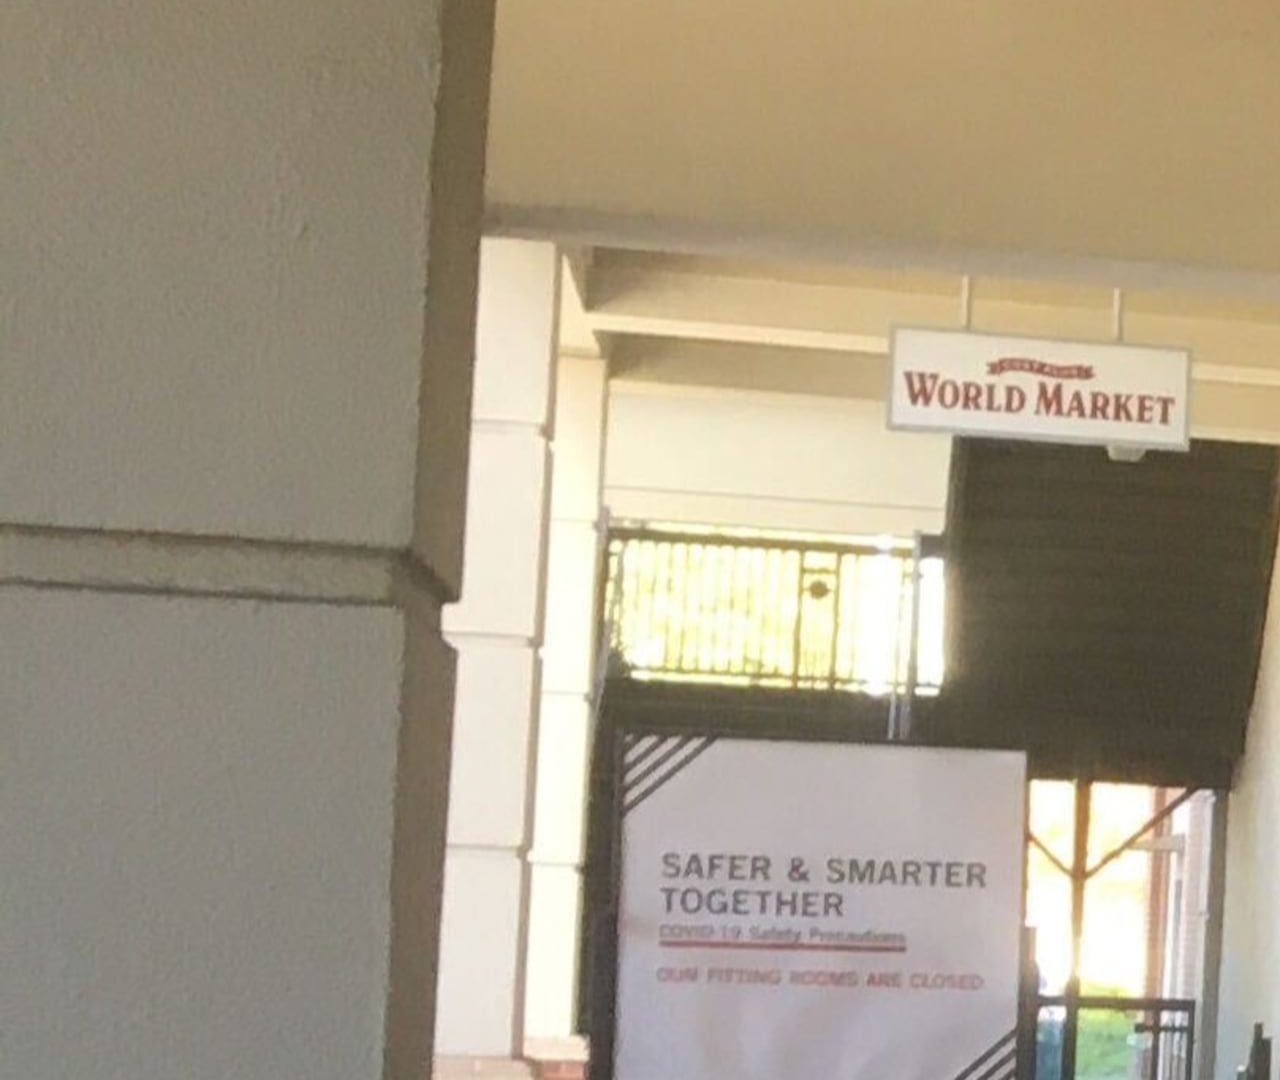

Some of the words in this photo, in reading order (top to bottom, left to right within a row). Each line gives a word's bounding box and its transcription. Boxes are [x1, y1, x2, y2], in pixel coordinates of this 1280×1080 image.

[903, 370, 1027, 414] WORLD
[1034, 380, 1177, 425] MARKET
[661, 852, 771, 881] SAFER
[787, 857, 809, 883] &
[826, 857, 988, 888] SMARTER
[659, 886, 844, 917] TOGETHER
[706, 969, 782, 986] FITTING
[908, 973, 986, 991] CLOSED
